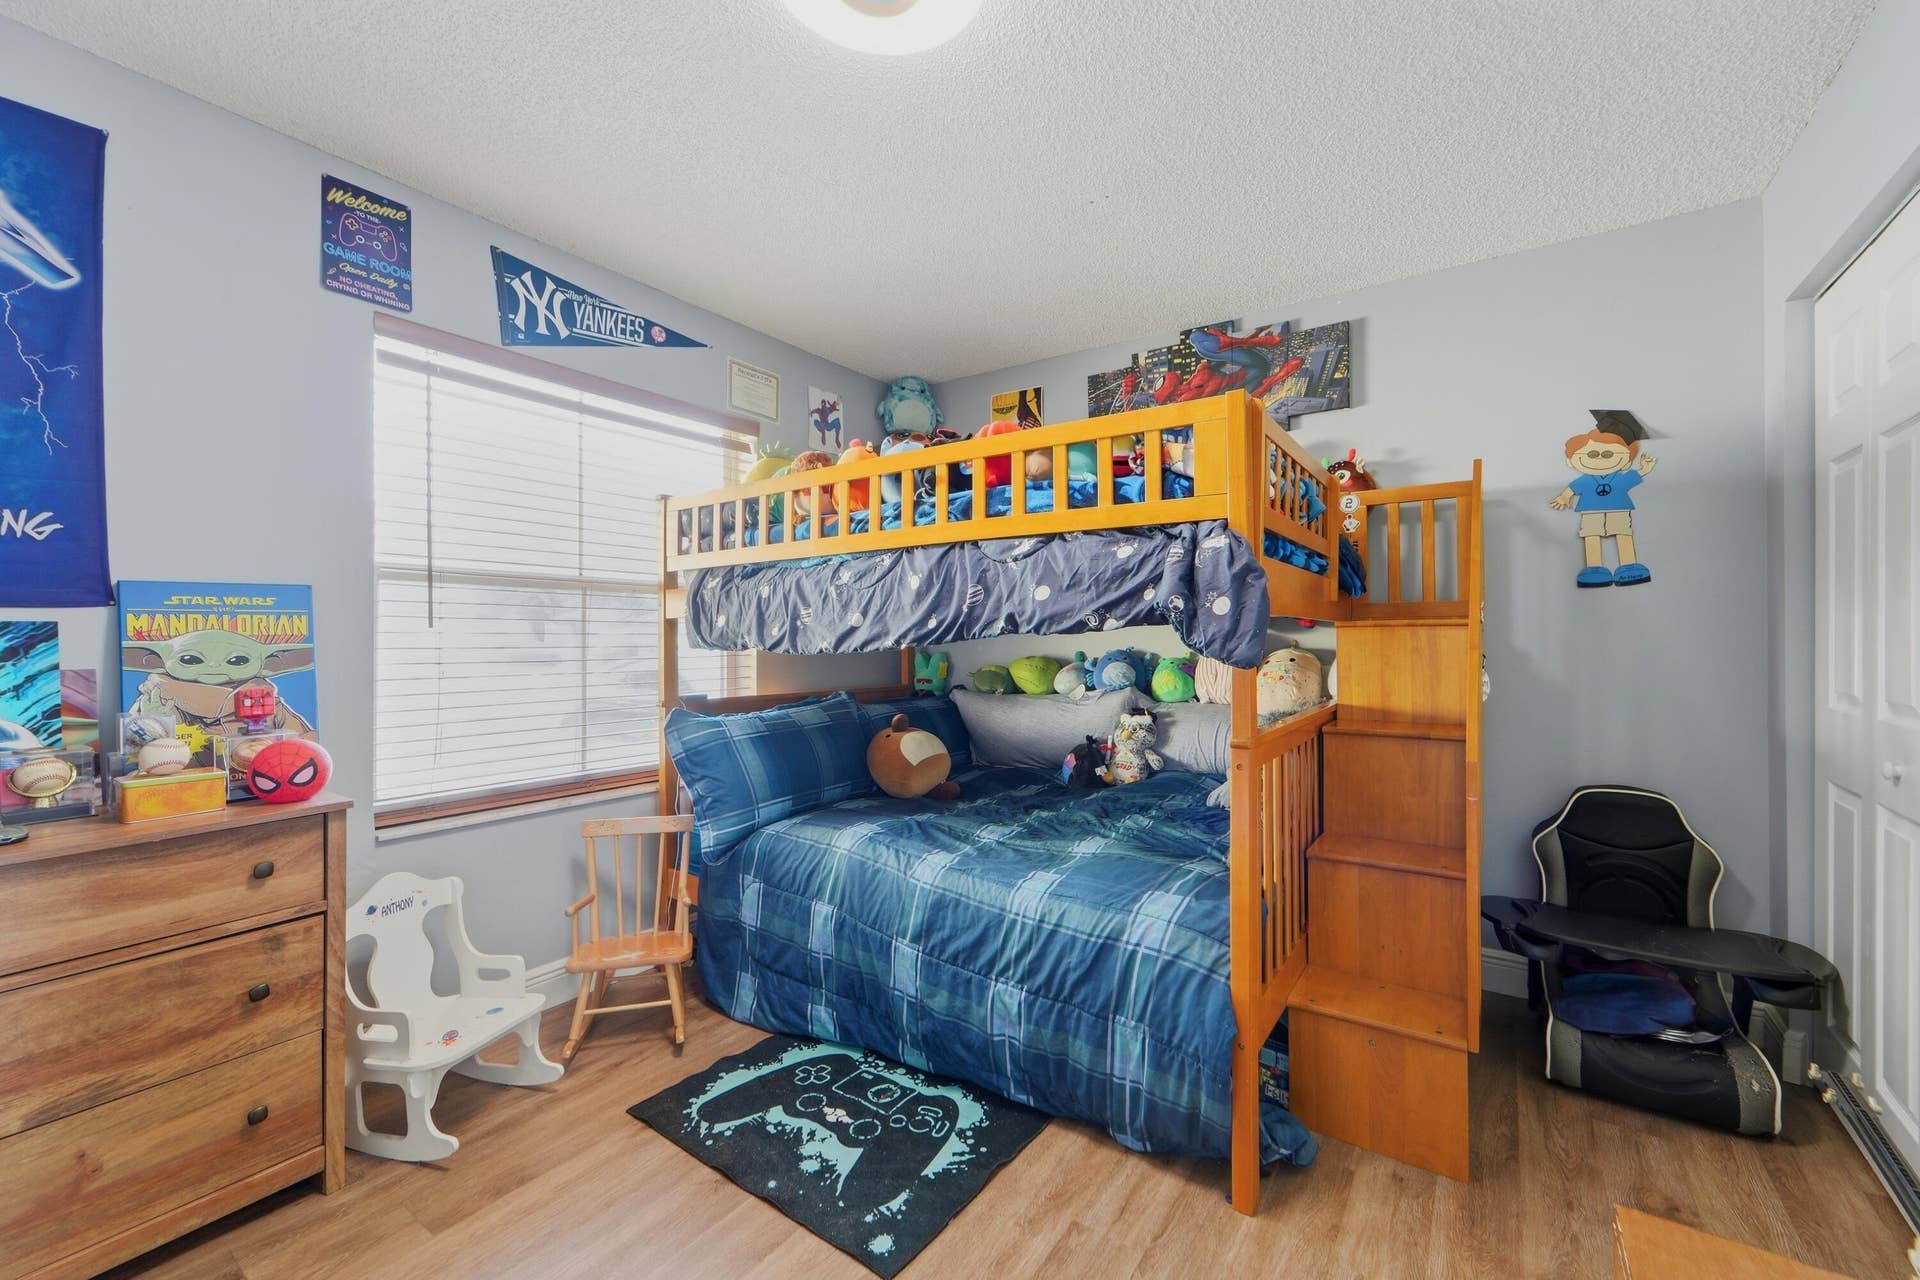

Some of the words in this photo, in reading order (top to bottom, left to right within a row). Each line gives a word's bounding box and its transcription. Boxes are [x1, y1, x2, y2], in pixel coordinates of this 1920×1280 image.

[326, 187, 407, 221] Welcome
[356, 211, 366, 219] TO
[323, 242, 366, 266] GAME
[370, 258, 411, 280] ROOM
[339, 275, 353, 285] NO
[354, 279, 398, 300] CHEATING,
[340, 262, 368, 278] Open
[370, 272, 398, 288] Daily
[326, 279, 359, 295] CRYING
[360, 290, 373, 300] OR
[373, 294, 411, 311] WHINING
[568, 289, 584, 302] New
[574, 301, 645, 343] YANKEES
[0, 508, 65, 541] NG
[164, 595, 222, 606] STAR
[222, 596, 277, 607] WARS
[126, 613, 308, 640] MANDALORIAN
[382, 896, 414, 917] ANTHONY
